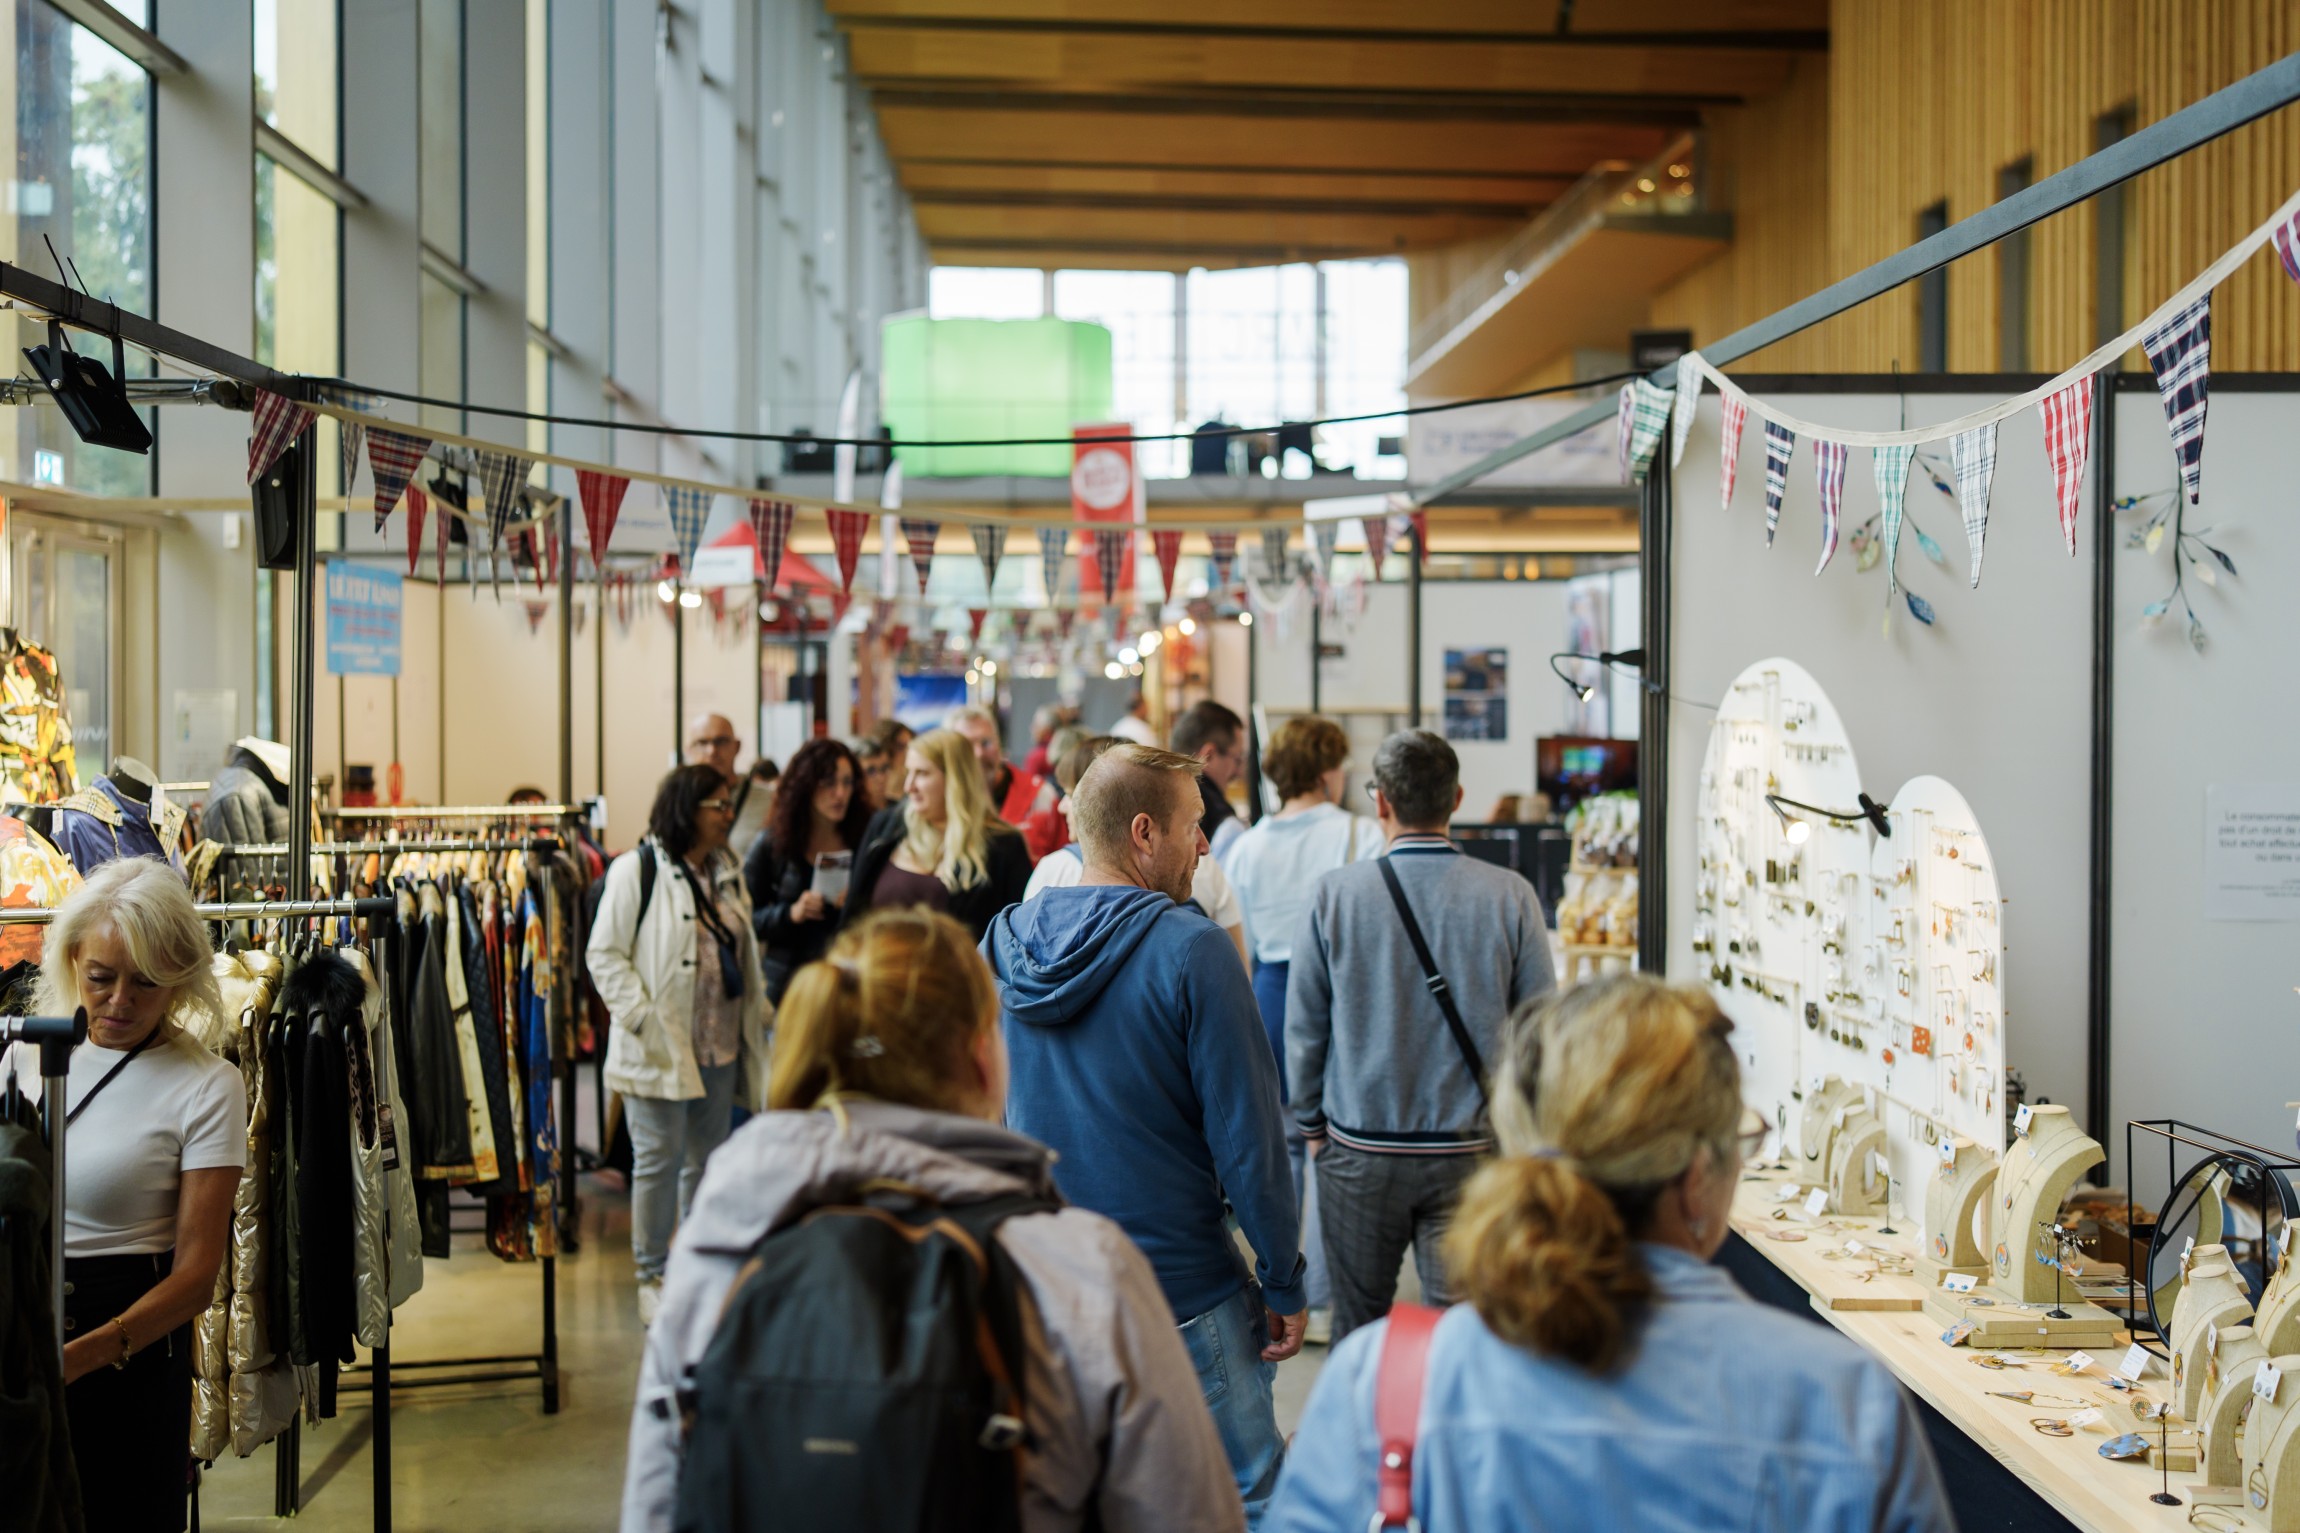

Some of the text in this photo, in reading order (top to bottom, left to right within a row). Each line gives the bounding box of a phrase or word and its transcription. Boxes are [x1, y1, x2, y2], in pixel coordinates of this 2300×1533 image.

[2262, 824, 2282, 835] droit
[2285, 825, 2296, 834] de
[2240, 838, 2265, 848] achat
